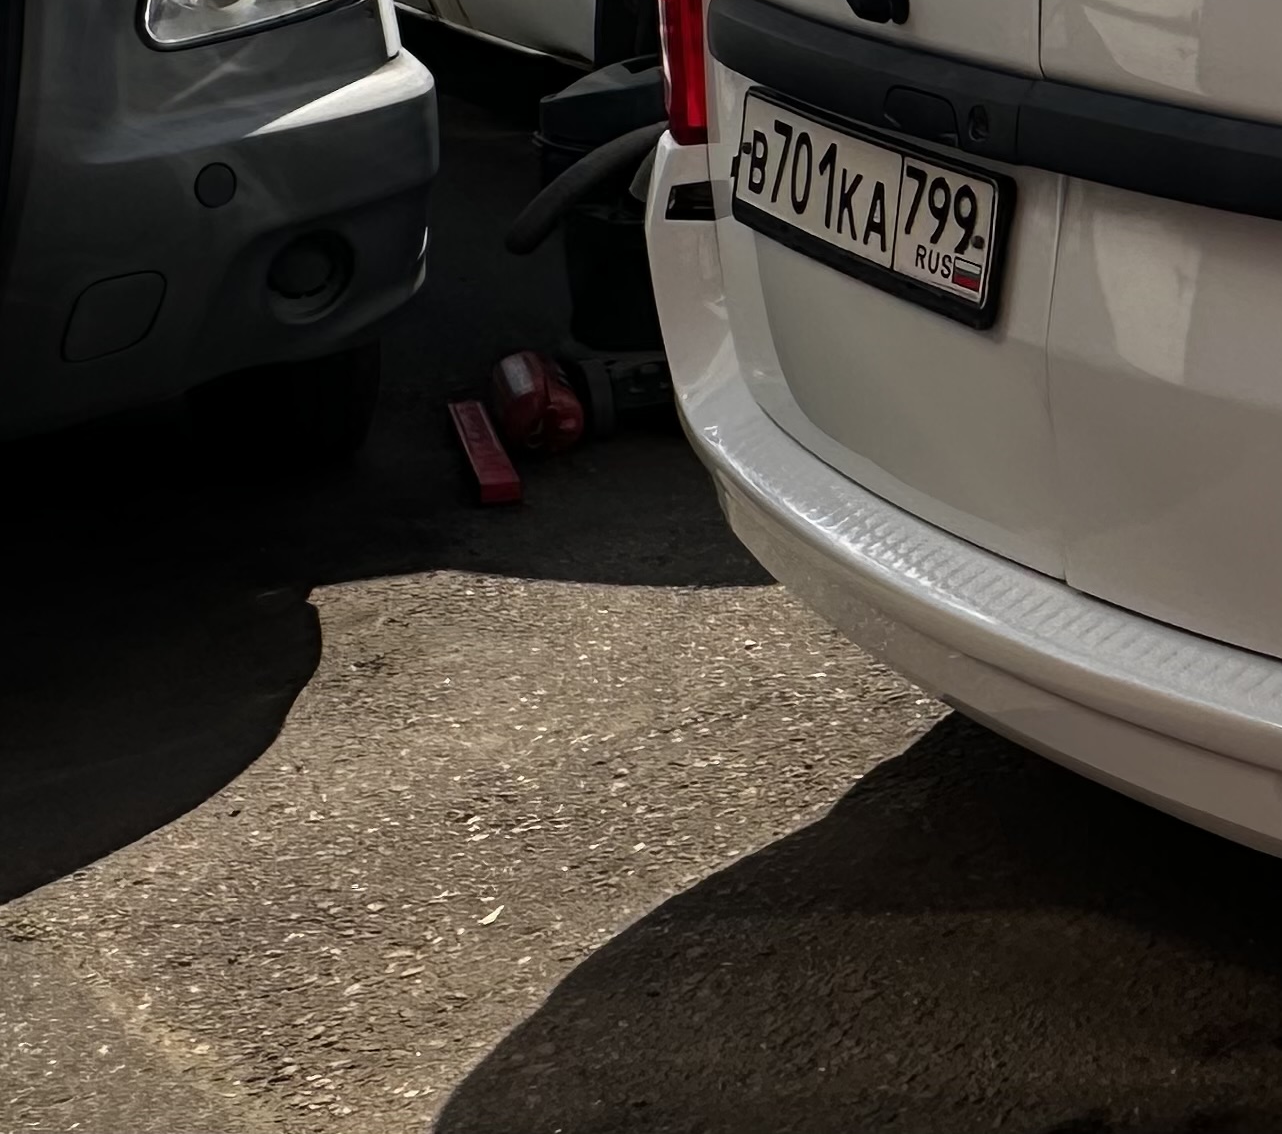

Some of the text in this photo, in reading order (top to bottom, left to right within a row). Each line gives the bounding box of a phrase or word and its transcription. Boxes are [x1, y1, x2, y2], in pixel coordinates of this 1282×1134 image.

[748, 119, 978, 255] В701КА 799
[914, 244, 952, 279] RUS
